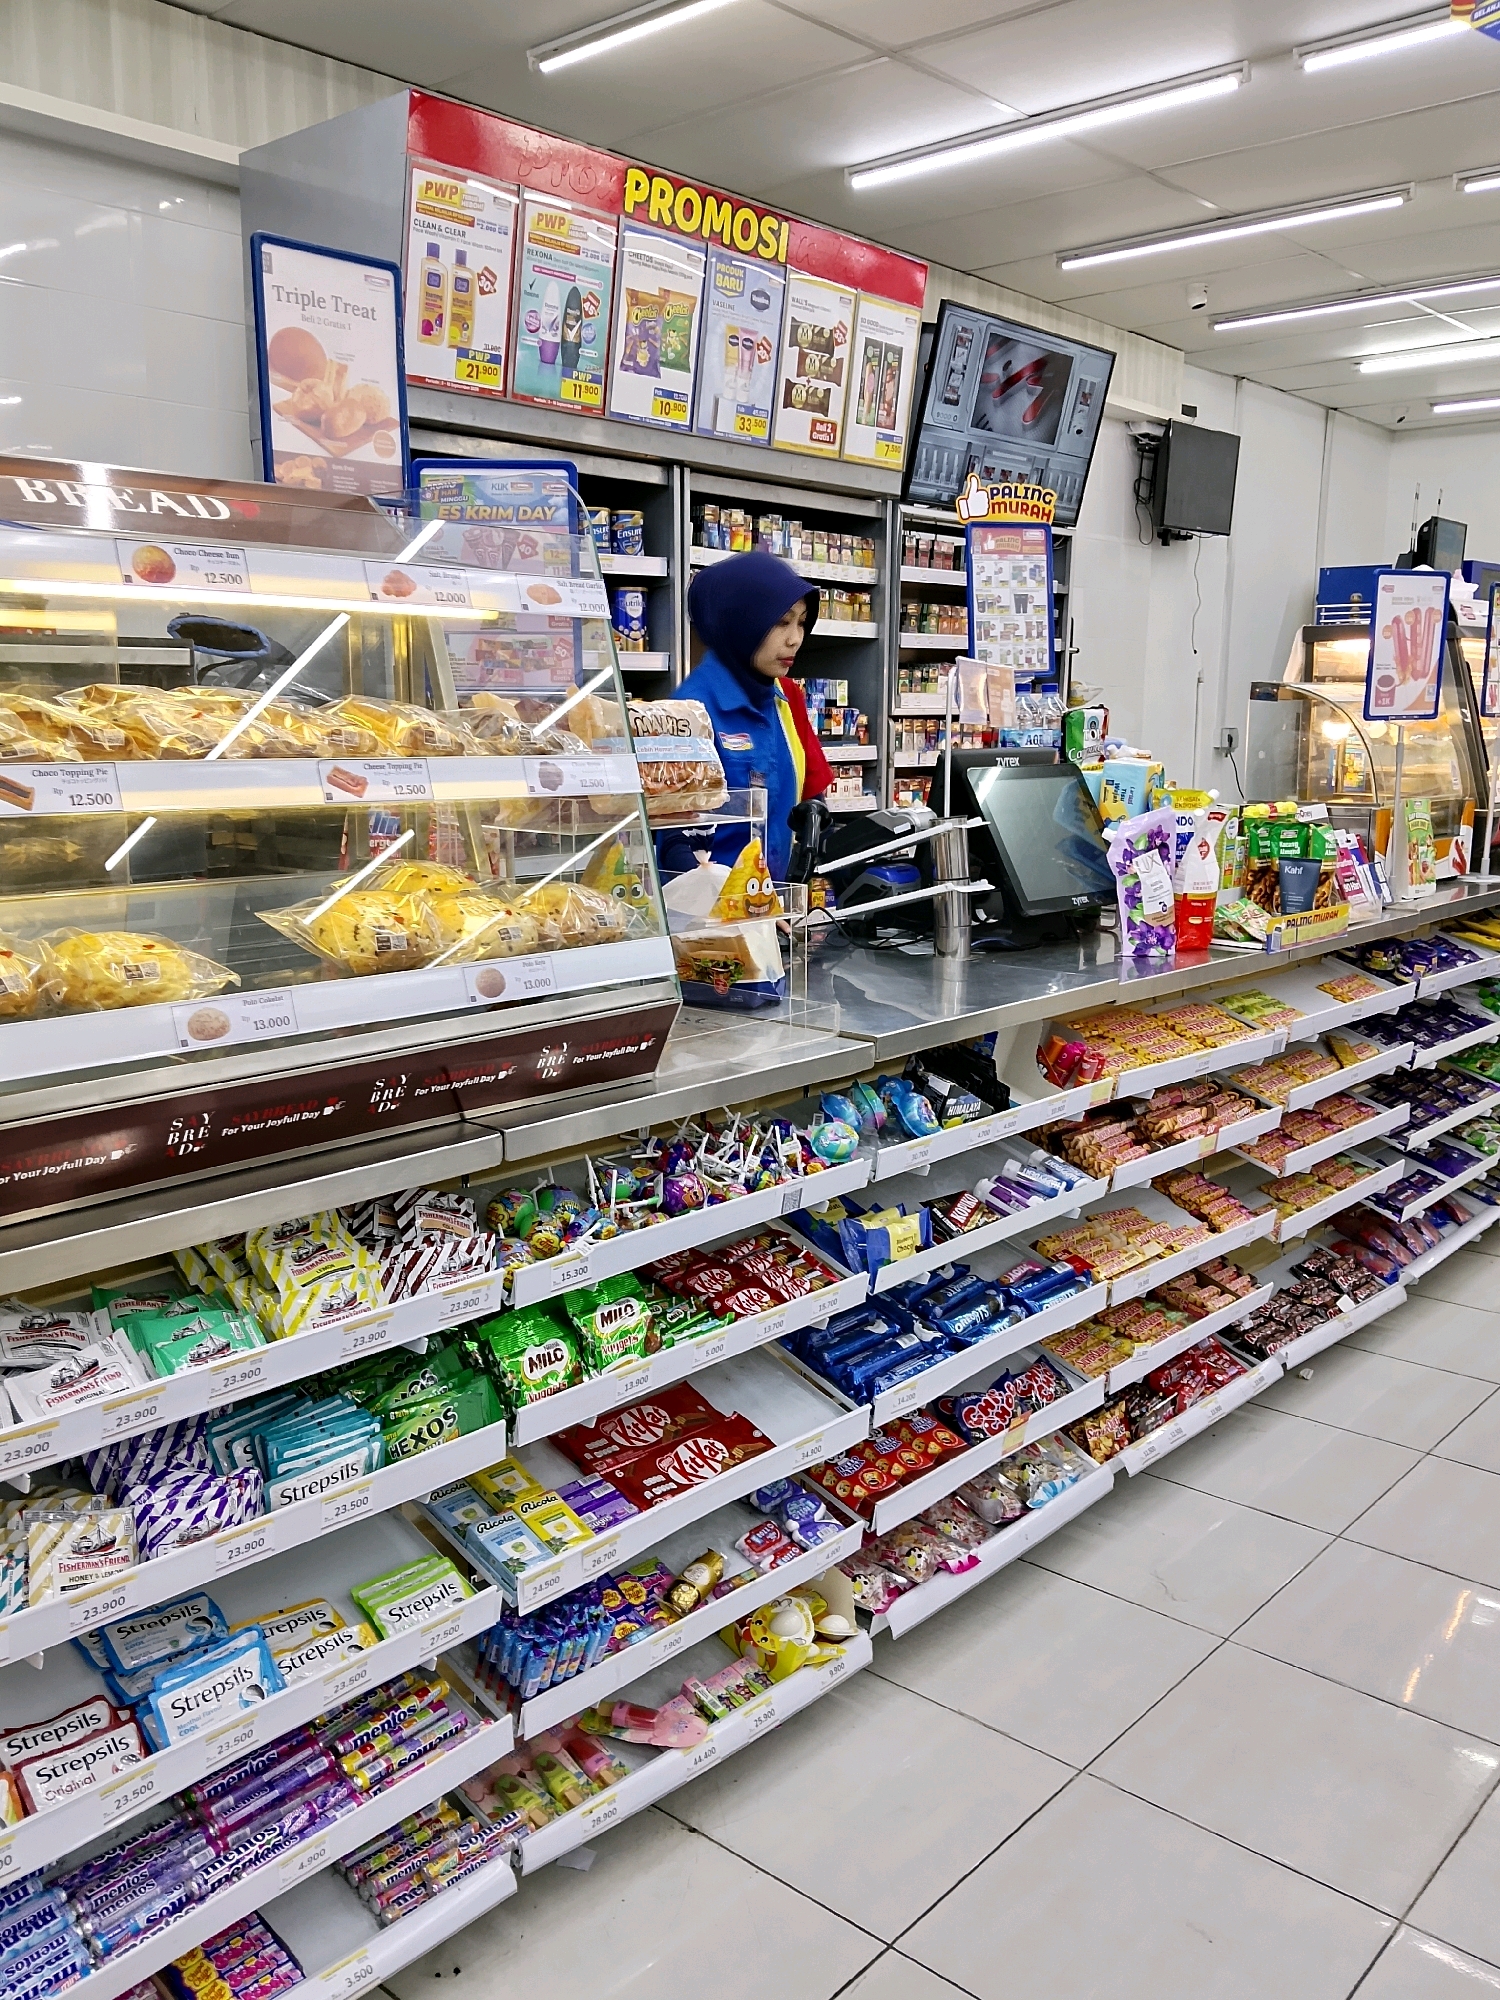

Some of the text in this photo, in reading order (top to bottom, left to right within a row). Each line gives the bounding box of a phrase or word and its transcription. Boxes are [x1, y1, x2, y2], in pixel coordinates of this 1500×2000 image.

[1474, 2, 1500, 19] BELANJ
[425, 181, 458, 200] PWP
[537, 212, 566, 229] PWP
[624, 168, 789, 263] PROMOSI
[414, 218, 436, 231] CLEAN
[445, 227, 466, 238] CLEAR
[527, 248, 553, 260] REXONA
[628, 251, 653, 263] CHEETOS
[717, 263, 744, 278] PRODUK
[716, 276, 744, 292] BARU
[272, 284, 377, 321] Triple Treat
[712, 299, 735, 311] VASELINE
[469, 350, 490, 361] PWP
[466, 363, 497, 379] 21.900
[573, 371, 591, 381] PWP
[573, 384, 598, 398] 11.900
[659, 401, 686, 416] 10.900
[739, 417, 766, 432] 33.500
[15, 479, 230, 520] BREAD
[990, 485, 1054, 505] PALING
[438, 506, 557, 520] ES KRIM DAY
[991, 500, 1051, 522] MURAH
[617, 528, 642, 538] Ensure
[174, 547, 240, 560] Choco Cheese Bun
[204, 572, 242, 586] 12.500
[435, 592, 466, 603] 12.000
[579, 603, 606, 613] 12.000
[1083, 729, 1103, 740] TOP
[387, 763, 412, 771] Topping
[996, 755, 1020, 767] zyrex
[32, 768, 108, 778] Choco Topping Pie
[580, 779, 605, 788] 12.500
[69, 793, 113, 806] 12.500
[1279, 841, 1299, 849] Kacang
[1285, 865, 1303, 874] Kahf
[1072, 895, 1089, 905] zyrex
[1286, 910, 1338, 928] PALING MURAH
[524, 978, 551, 991] 13.000
[573, 1044, 638, 1064] For Your Joyfull Day
[370, 1085, 407, 1104] BRE
[415, 1073, 496, 1097] For Your Joyfull Day
[232, 1100, 319, 1124] SAYBREAD
[947, 1100, 981, 1116] HIMALAYA
[221, 1109, 320, 1137] For Your Joyfull Day
[167, 1125, 210, 1145] BRE
[977, 1129, 990, 1138] 4.700
[911, 1149, 929, 1161] 30.700
[0, 1155, 107, 1185] or Your Joyfull Day
[950, 1192, 979, 1224] KOPIKO
[896, 1242, 914, 1253] Choco
[291, 1251, 346, 1276] FISHERMAN'S FRIEND
[315, 1263, 336, 1274] LEMON
[561, 1266, 588, 1283] 15.300
[696, 1269, 731, 1293] KitKat
[450, 1297, 480, 1313] 23.900
[731, 1289, 770, 1314] KitKat
[818, 1298, 838, 1312] 15.700
[600, 1303, 636, 1329] MILO
[1109, 1303, 1142, 1326] SILVERQUEEN
[1129, 1313, 1163, 1336] SILVERQUEEN
[6, 1329, 86, 1343] FISHERMAN'S FRIEND
[763, 1319, 784, 1334] 13.700
[353, 1330, 387, 1348] 23.900
[601, 1334, 639, 1354] Nuggets
[1055, 1330, 1089, 1356] SILVERQUEEN
[528, 1347, 565, 1373] MILO
[705, 1343, 724, 1357] 5.000
[1075, 1343, 1113, 1368] SILVERQUEEN
[222, 1368, 261, 1387] 23.900
[624, 1375, 649, 1393] 13.900
[527, 1380, 567, 1404] Nuggets
[115, 1405, 158, 1429] 23.900
[611, 1406, 671, 1446] KitKat
[388, 1405, 459, 1461] HEXOS
[4, 1441, 51, 1464] 23.900
[669, 1439, 728, 1484] KitKat
[614, 1469, 625, 1478] 6
[279, 1461, 359, 1507] Strepsils
[429, 1481, 468, 1502] Ricola
[334, 1496, 369, 1517] 23.500
[520, 1494, 558, 1514] Ricola
[476, 1512, 516, 1534] Ricola
[227, 1537, 265, 1560] 23.900
[592, 1548, 617, 1569] 26.700
[58, 1554, 130, 1573] FISHERMAN'S FRIEND
[532, 1575, 561, 1596] 24.500
[82, 1596, 126, 1621] 23.900
[388, 1581, 458, 1623] Strepsils
[116, 1603, 203, 1640] Strepsils
[263, 1607, 327, 1639] trepsils
[430, 1624, 460, 1646] 27.500
[662, 1636, 682, 1652] 7.900
[278, 1629, 354, 1676] Strepsils
[829, 1662, 846, 1678] 9.900
[333, 1669, 367, 1694] 23.500
[170, 1665, 254, 1719] Strepsils
[351, 1702, 418, 1750] mentos
[754, 1708, 776, 1728] 25.900
[6, 1712, 101, 1757] Strepsils
[178, 1724, 199, 1737] COOL
[217, 1729, 254, 1755] 23.500
[397, 1725, 460, 1768] mentos
[35, 1735, 130, 1785] Strepsils
[693, 1746, 717, 1767] 44.400
[205, 1751, 278, 1798] mentos
[45, 1772, 97, 1802] Original
[114, 1780, 154, 1810] 23.500
[591, 1807, 618, 1828] 28.900
[458, 1810, 519, 1854] mentos
[298, 1848, 326, 1871] 4.900
[386, 1853, 430, 1886] mentos
[446, 1855, 488, 1887] mentos
[92, 1870, 149, 1908] mentos
[100, 1880, 157, 1919] mentos
[3, 1935, 67, 1978] mentos
[345, 1964, 373, 1988] 3.500
